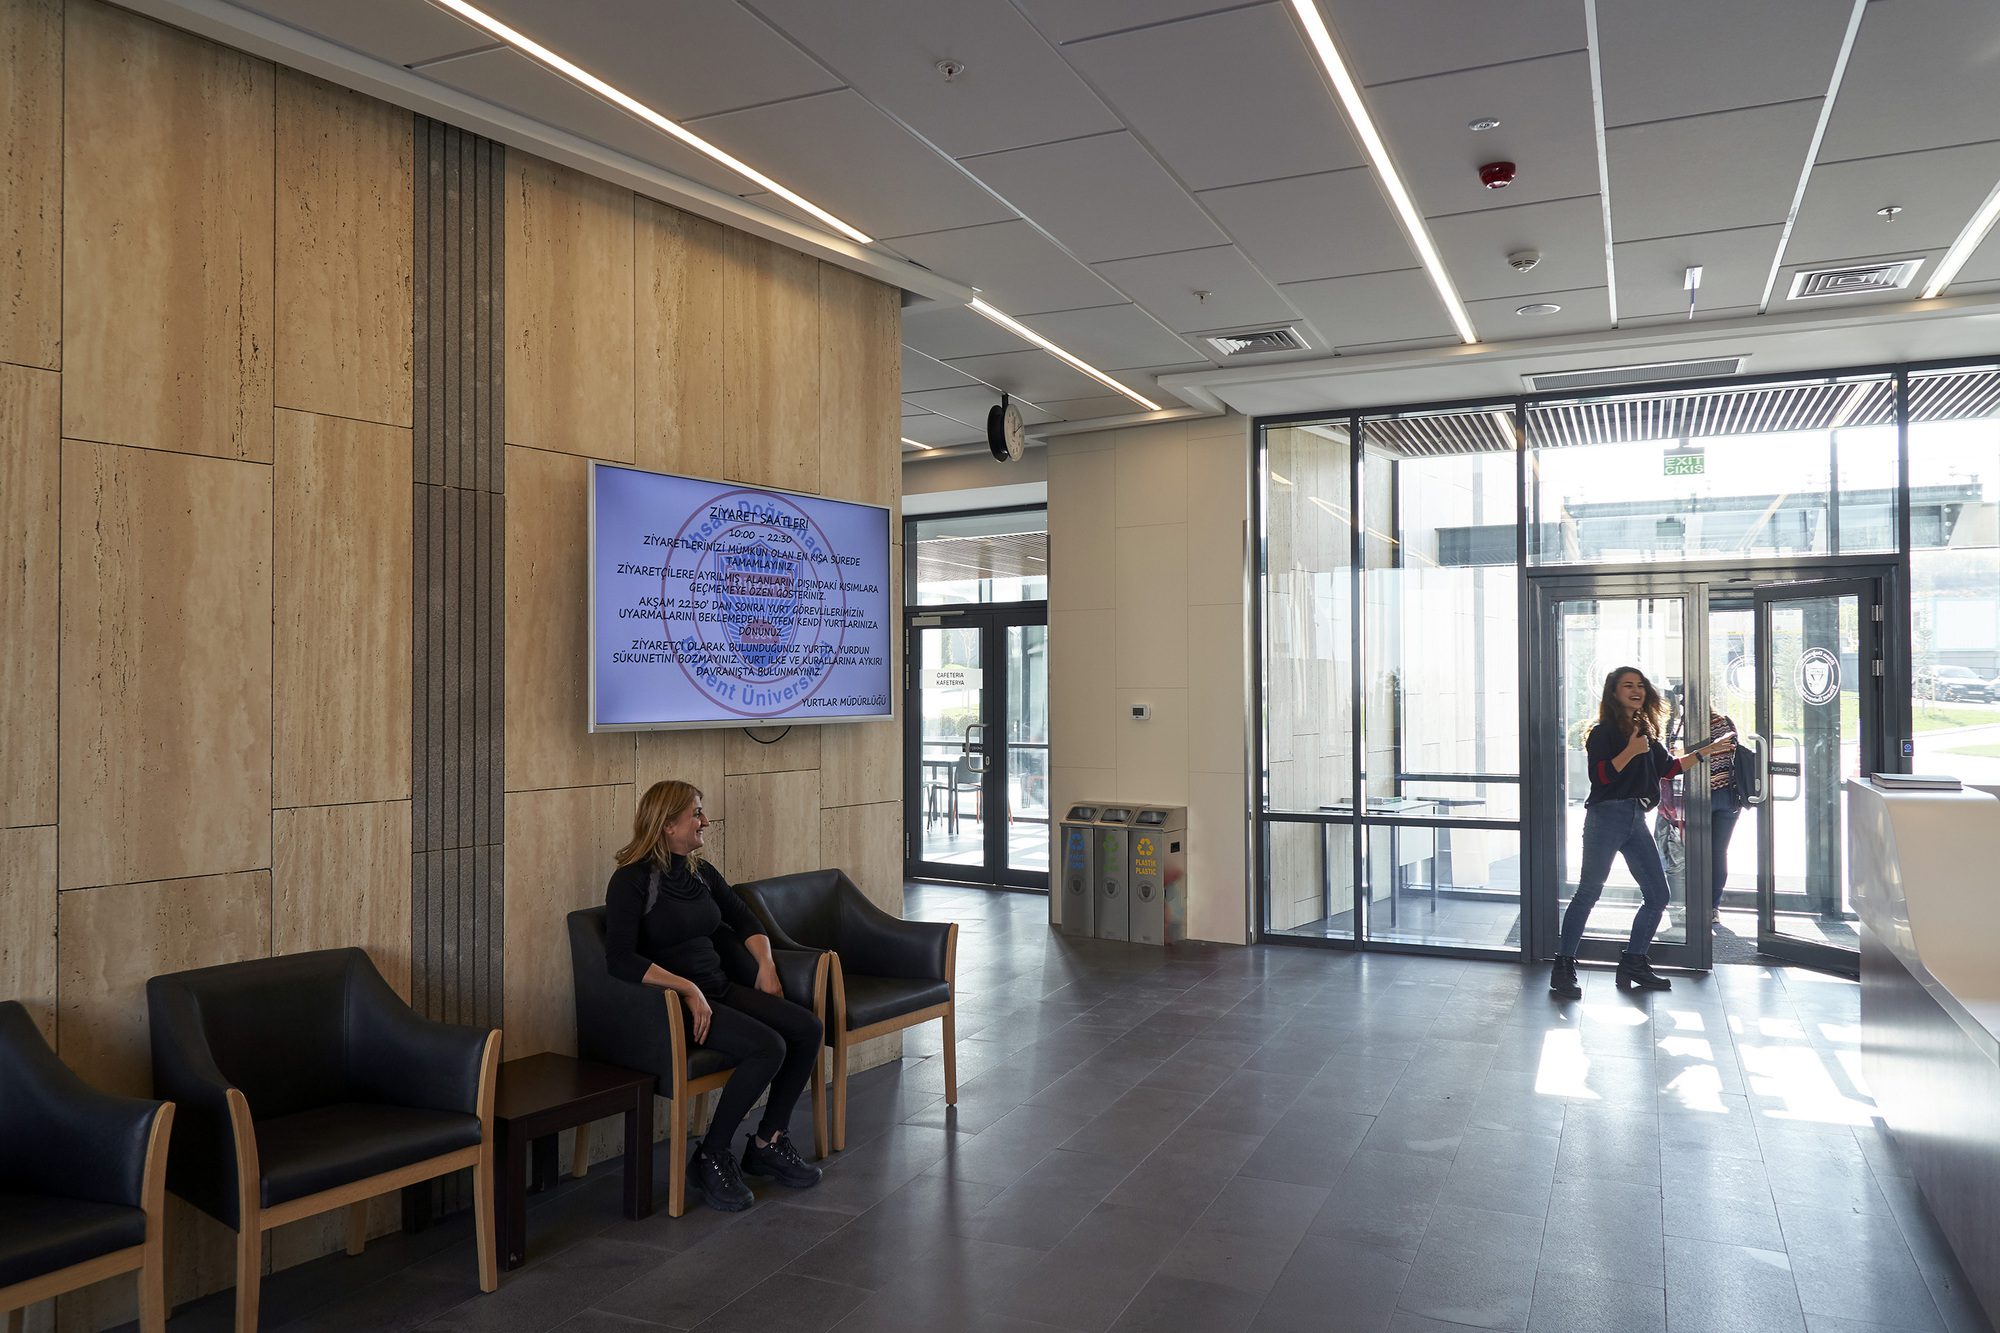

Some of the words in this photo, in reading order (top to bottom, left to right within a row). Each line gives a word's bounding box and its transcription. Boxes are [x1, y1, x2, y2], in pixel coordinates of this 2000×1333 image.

[1665, 456, 1703, 465] EXIT
[709, 504, 757, 522] ZİYARET
[760, 514, 809, 529] SAATLERİ
[729, 529, 755, 540] 10:00
[767, 533, 792, 543] 22:30
[643, 534, 725, 552] ZİYARETLERİNİZİ
[727, 543, 768, 557] MÜMKÜN
[771, 548, 794, 559] OLAN
[797, 551, 808, 560] EN
[811, 553, 828, 563] KISA
[831, 554, 861, 566] SÜREDE
[726, 557, 795, 571] TAMAMLAYINIZ.
[617, 562, 694, 580] ZİYARETÇİLERE
[697, 571, 740, 585] AYRILMIŞ
[746, 575, 794, 587] ALANLARIN
[839, 582, 879, 593] KISIMLARA
[689, 582, 746, 596] GEÇMEMEYE
[749, 585, 773, 597] ÖZEN
[777, 587, 827, 601] GÖSTERİNİZ.
[639, 597, 674, 609] AKŞAM
[712, 601, 731, 610] DAN
[735, 602, 765, 612] SONRA
[767, 604, 790, 613] YURT
[792, 605, 864, 618] GÖREVLİLERİMİZİN
[619, 609, 695, 621] UYARMALARINI
[698, 612, 759, 625] BEKLEMEDEN
[824, 619, 879, 629] YURTLARINIZA
[632, 638, 684, 654] ZİYARETÇİ
[687, 641, 725, 651] OLARAK
[729, 641, 800, 653] BULUNDUĞUNUZ
[839, 645, 870, 655] YURDUN
[613, 650, 675, 664] SÜKUNETİNİ
[743, 655, 765, 665] YURT
[768, 653, 787, 665] İLKE
[789, 656, 800, 665] VE
[802, 655, 857, 665] KURALLARINA
[858, 656, 883, 665] AYKIRI
[696, 667, 754, 679] DAVRANIŞTA
[758, 667, 822, 677] BULUNMAYINIZ.
[801, 697, 838, 707] YURTLAR
[840, 694, 887, 707] MÜDÜRLÜĞÜ
